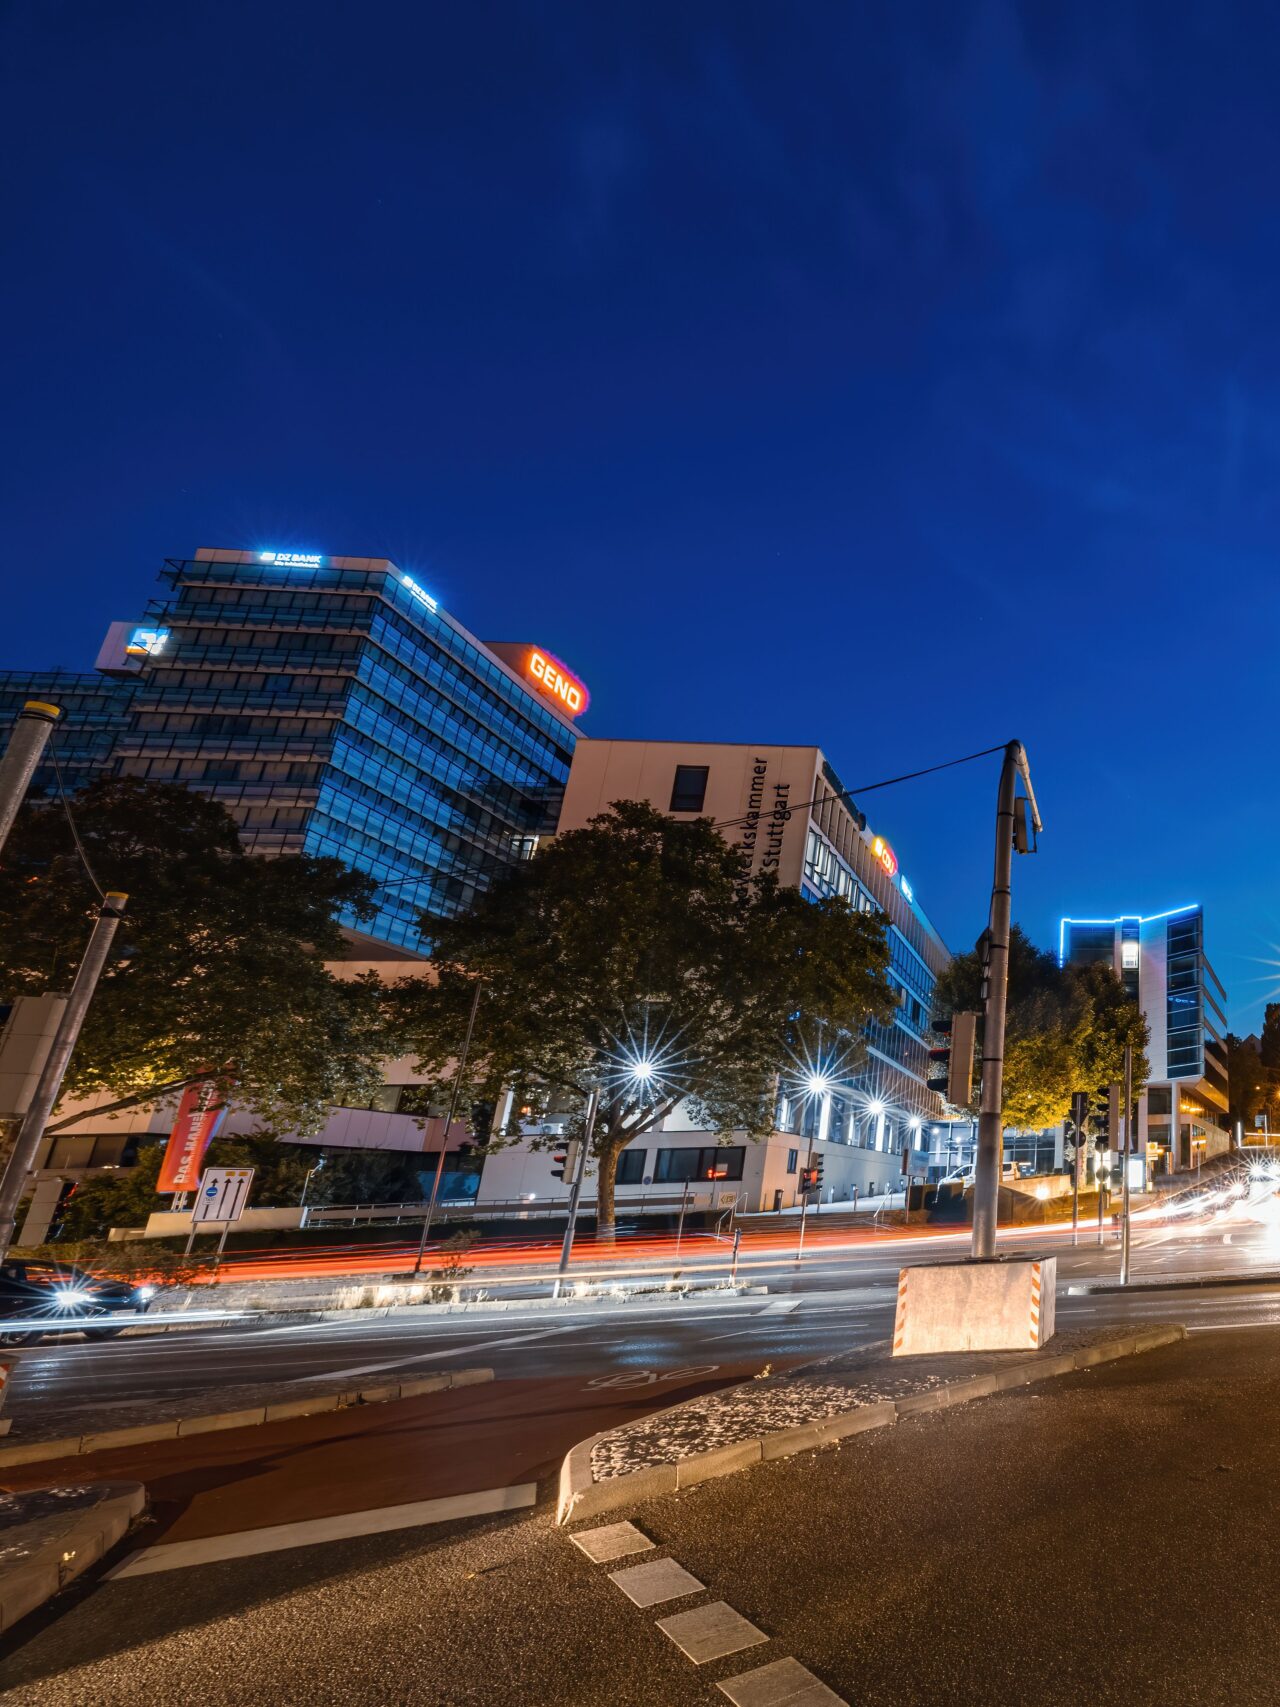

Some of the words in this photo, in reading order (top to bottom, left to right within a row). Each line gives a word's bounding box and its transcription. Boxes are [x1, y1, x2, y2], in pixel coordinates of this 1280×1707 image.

[291, 554, 322, 563] BANK
[530, 653, 581, 711] GENO
[763, 784, 792, 868] Stuttgart
